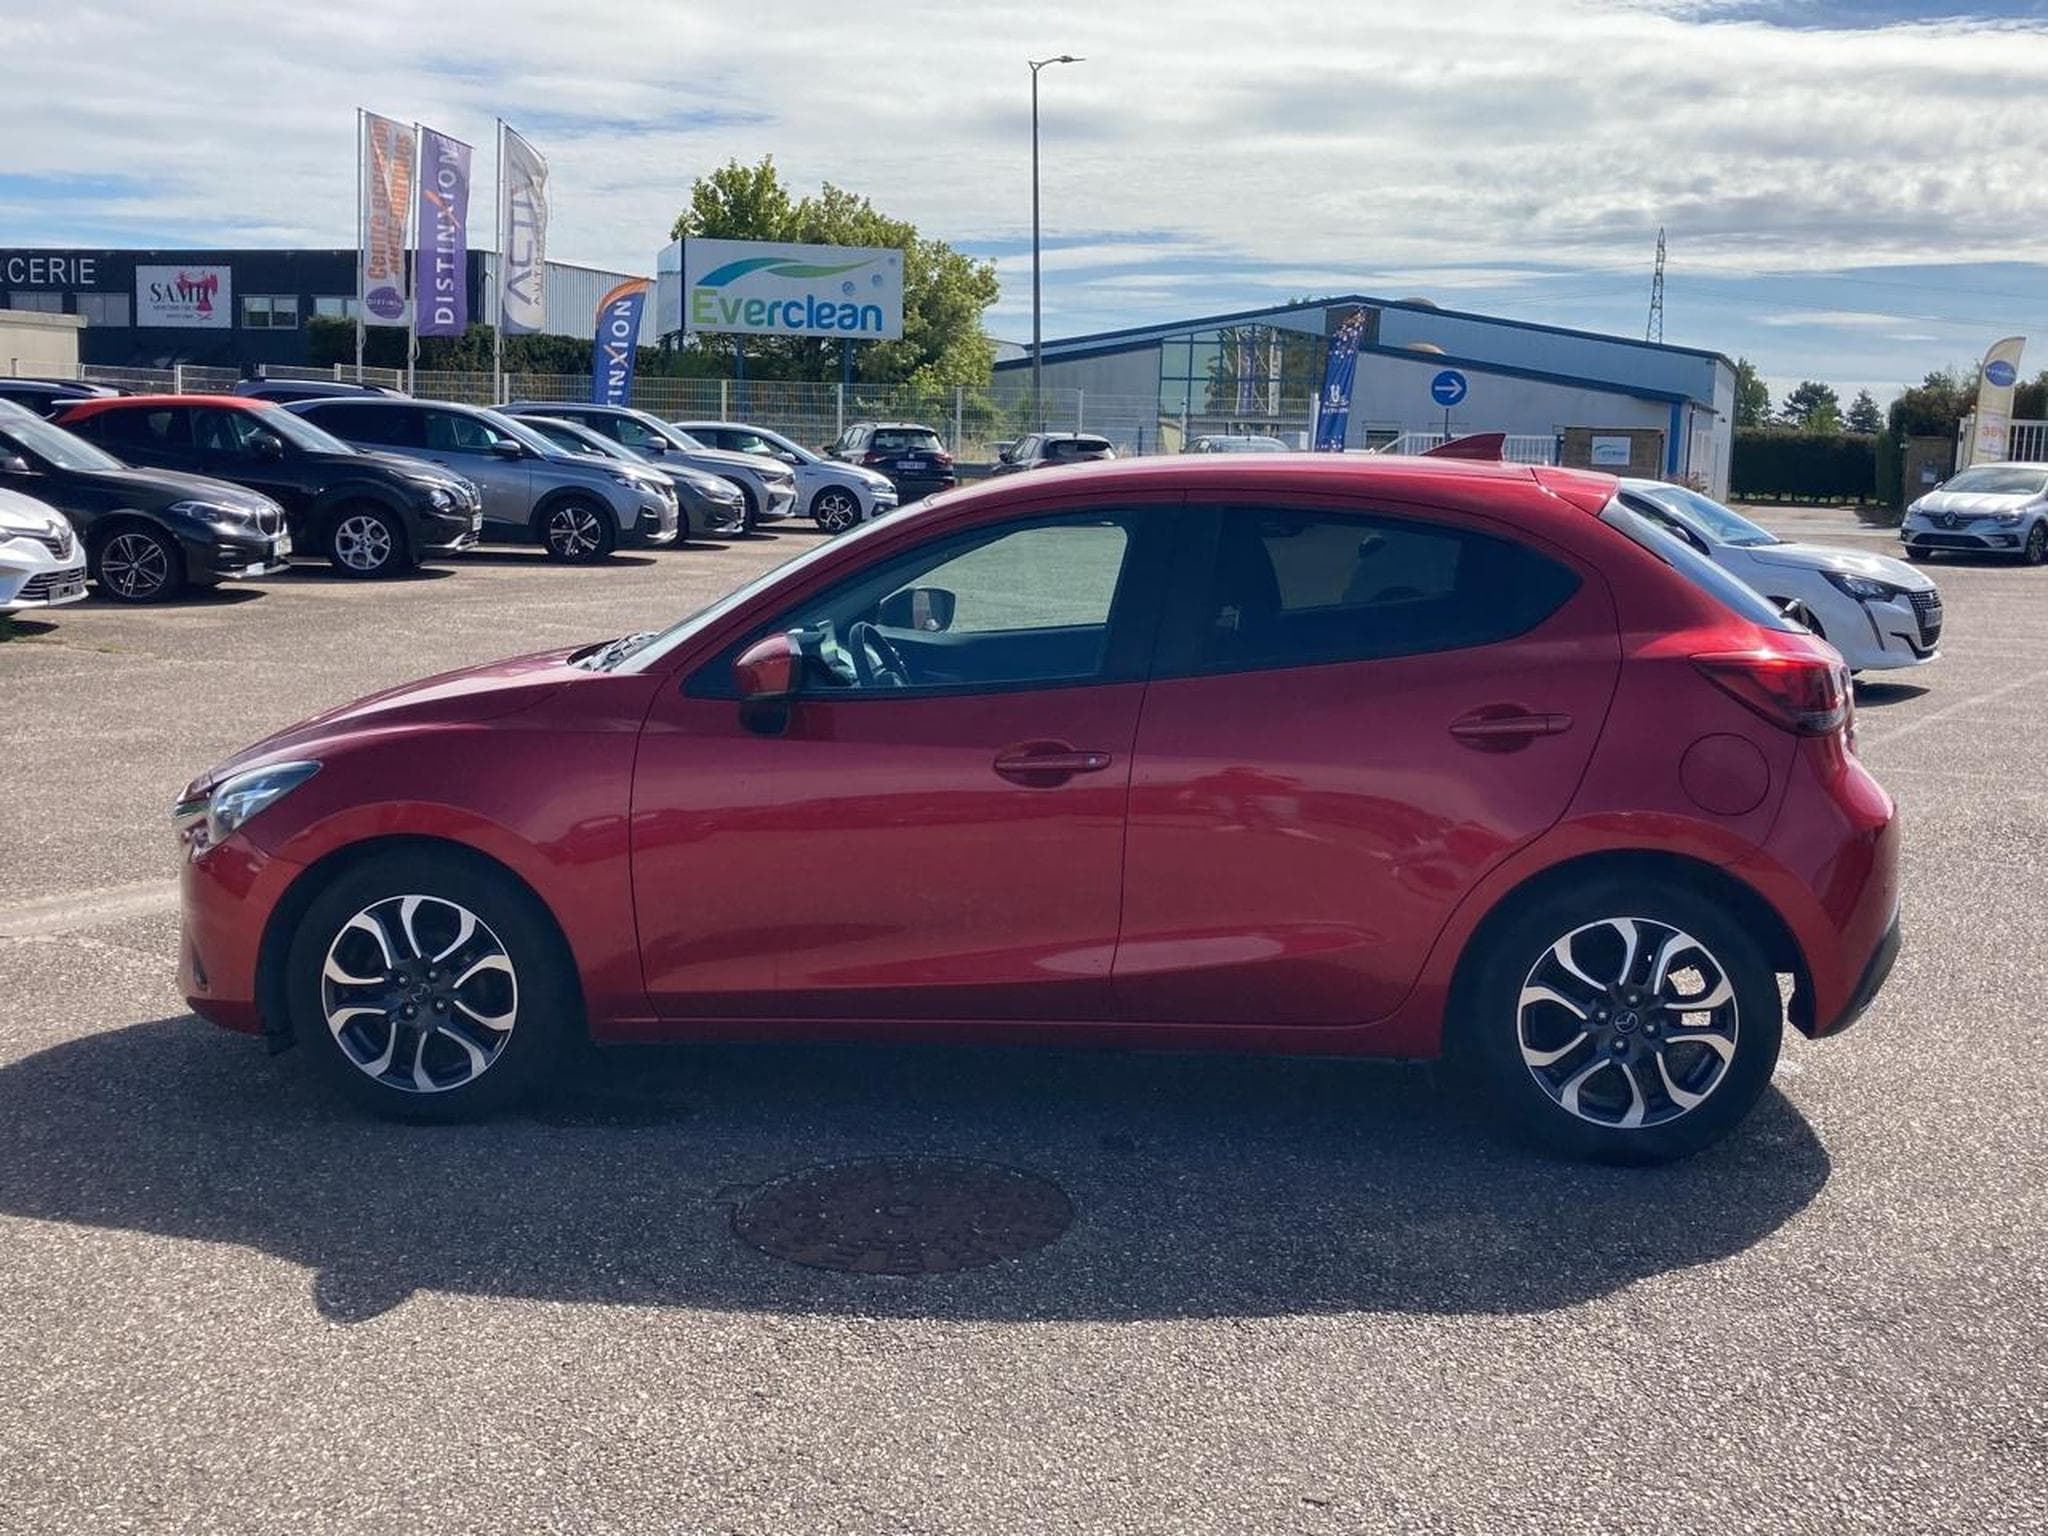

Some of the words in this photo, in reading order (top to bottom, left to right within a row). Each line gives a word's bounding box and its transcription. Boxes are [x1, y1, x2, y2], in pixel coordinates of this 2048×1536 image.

[431, 145, 460, 325] DISTINXION
[0, 257, 96, 284] CERIE
[691, 288, 883, 332] Everclean
